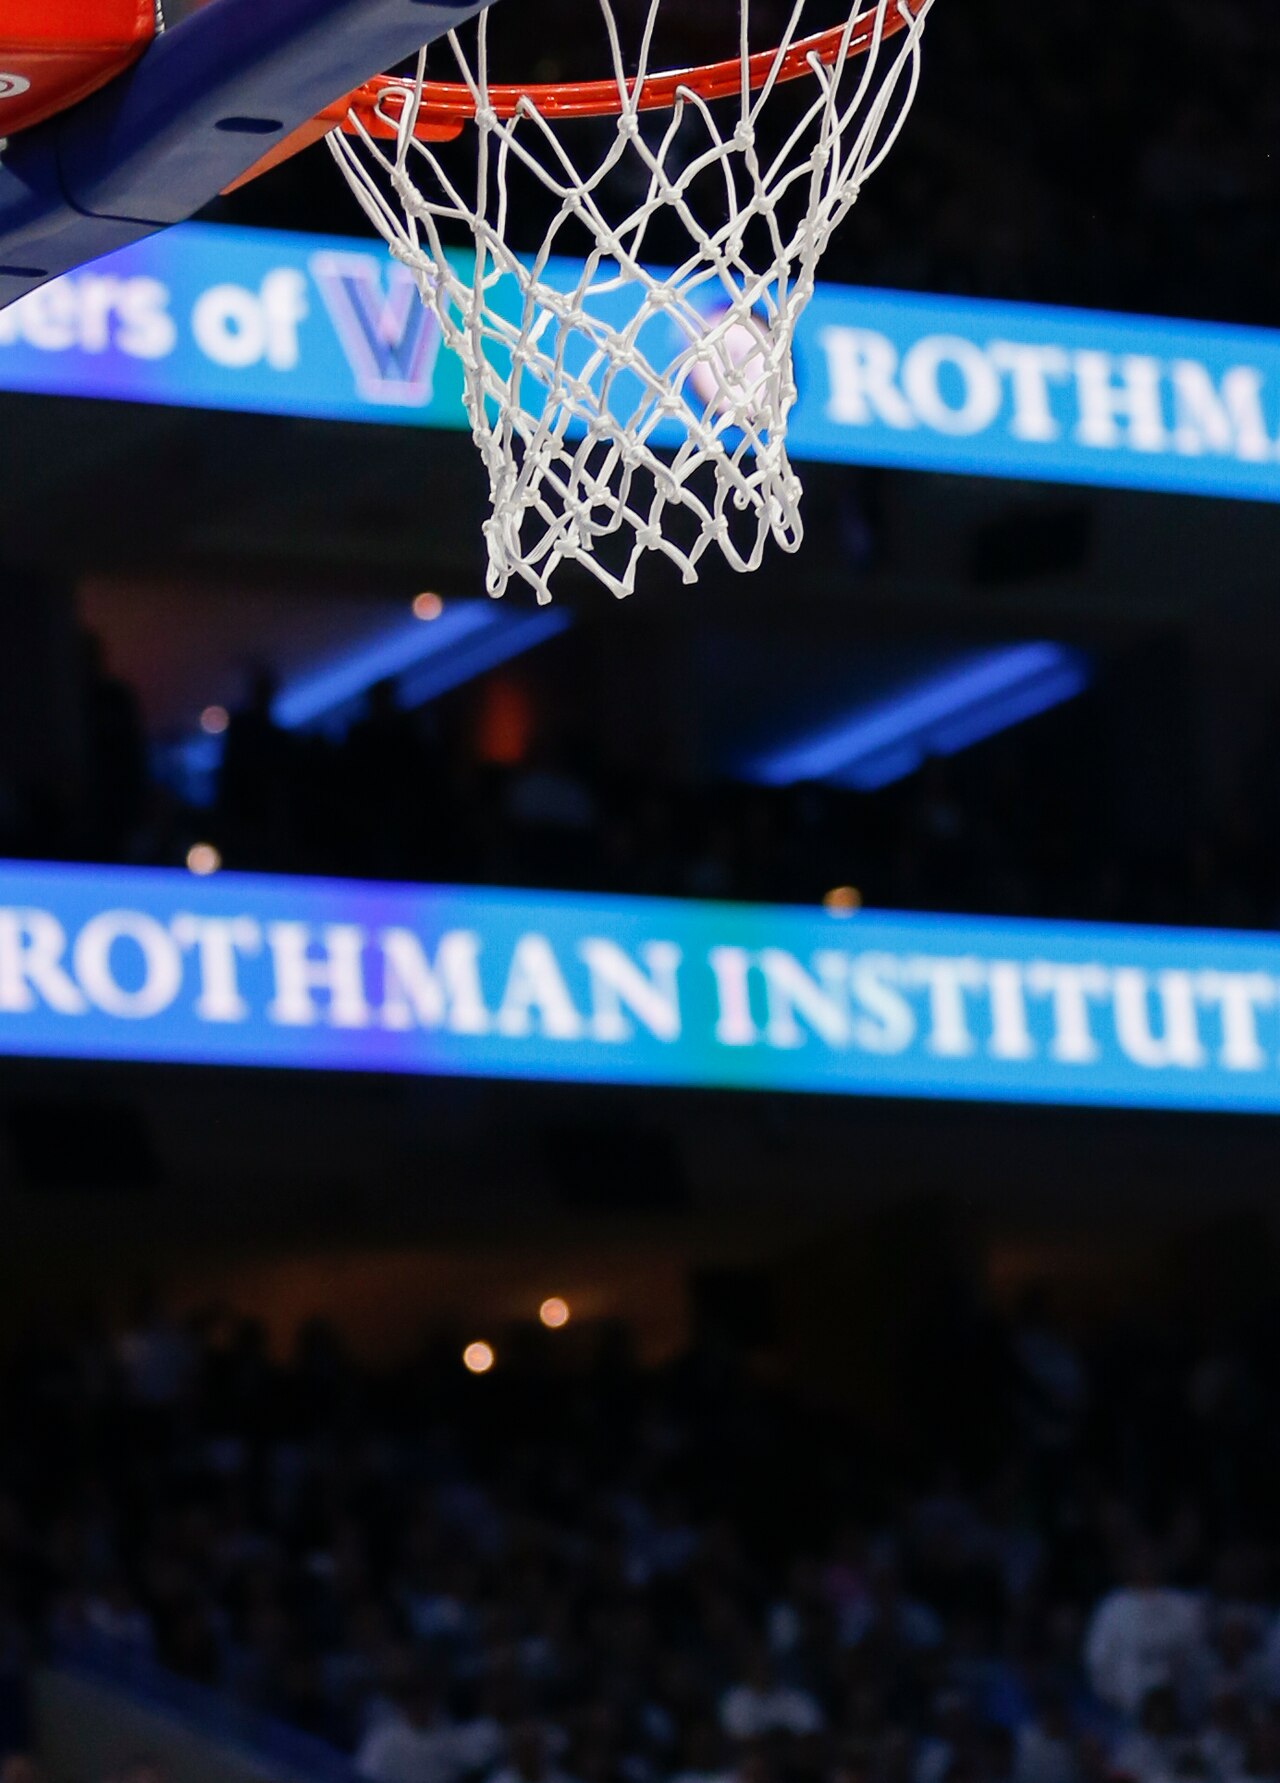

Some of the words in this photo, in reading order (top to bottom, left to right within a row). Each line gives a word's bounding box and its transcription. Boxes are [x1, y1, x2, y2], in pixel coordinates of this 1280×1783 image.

[0, 275, 177, 361] ers
[191, 267, 306, 371] of
[0, 905, 683, 1043] ROTHMAN
